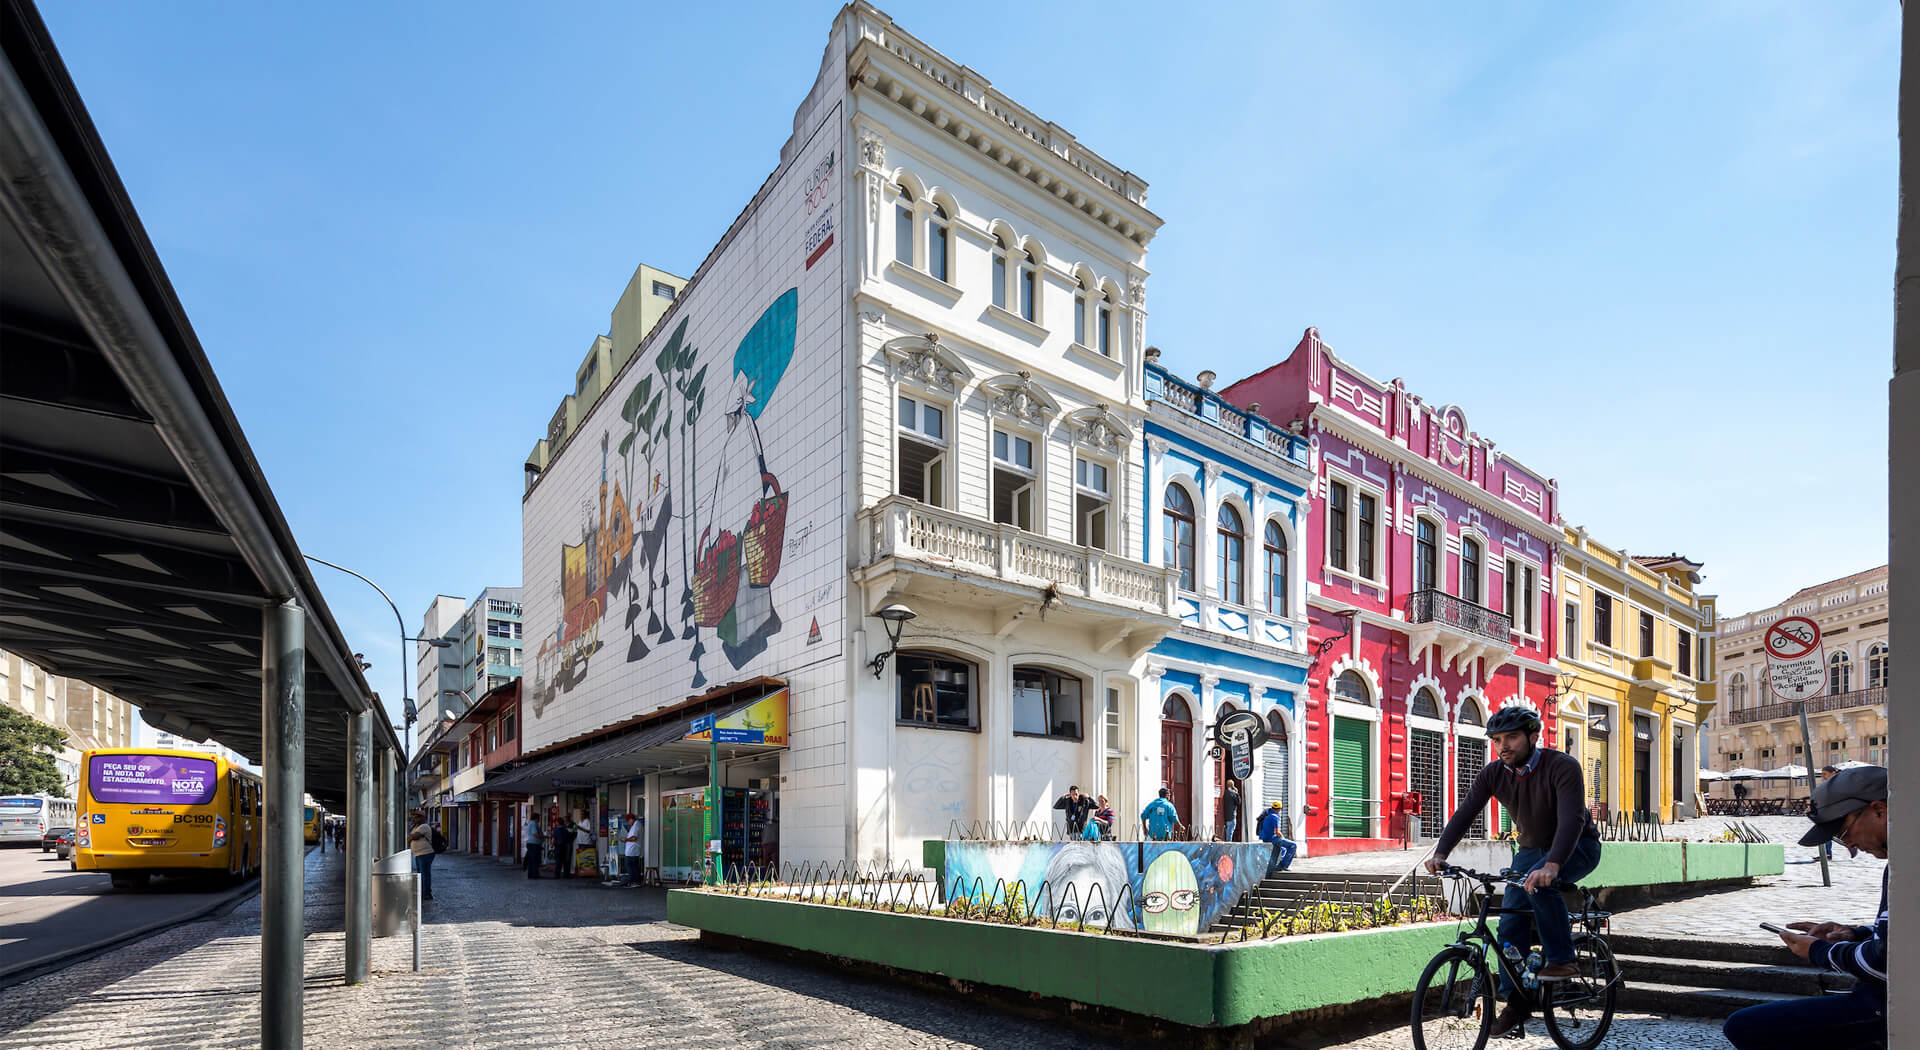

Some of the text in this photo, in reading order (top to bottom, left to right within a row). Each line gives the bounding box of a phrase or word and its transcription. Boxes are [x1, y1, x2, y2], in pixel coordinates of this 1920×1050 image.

[805, 215, 834, 256] FEDERAL
[1776, 660, 1816, 670] Permitido
[1787, 675, 1808, 683] Evite
[1212, 748, 1220, 757] 51
[103, 763, 122, 771] PEÇA
[172, 781, 204, 789] NOTA
[173, 814, 214, 824] BC190
